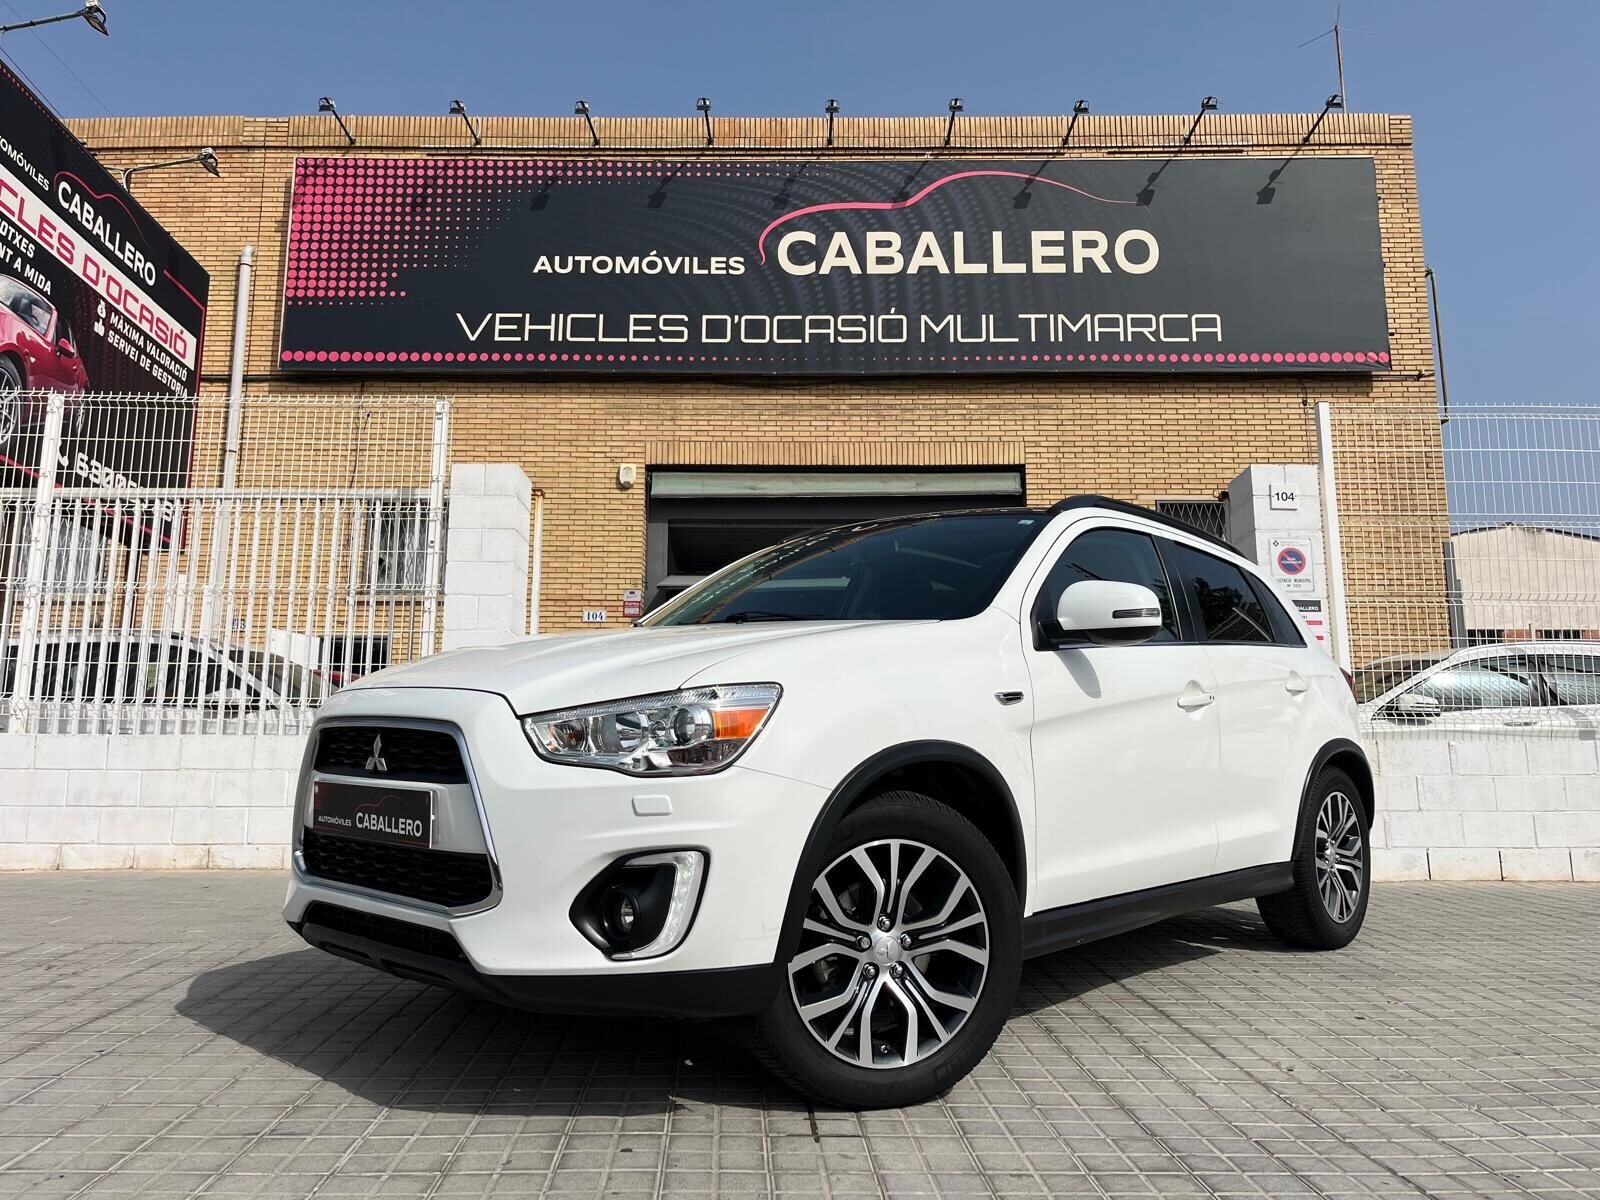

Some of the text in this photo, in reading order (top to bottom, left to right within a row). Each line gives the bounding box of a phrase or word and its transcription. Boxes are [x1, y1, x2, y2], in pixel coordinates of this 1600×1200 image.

[0, 136, 156, 287] OMÓVILES CABALLERO
[0, 217, 36, 259] OTXES
[532, 229, 1160, 276] AUTOMÓVILES CABALLERO
[12, 256, 22, 273] A
[24, 263, 52, 295] MIDA
[82, 253, 188, 360] D'OCASIÓ
[456, 307, 1222, 344] VEHICLES D'OCASIÓ MULTIMARCA
[107, 329, 188, 399] SERVEI DE GESTORIA
[109, 311, 188, 382] MÀXIMA VALORACIÓ
[1274, 491, 1295, 502] 104
[587, 612, 603, 620] 104
[318, 812, 423, 837] AUTOMÓVILES CABALLERO
